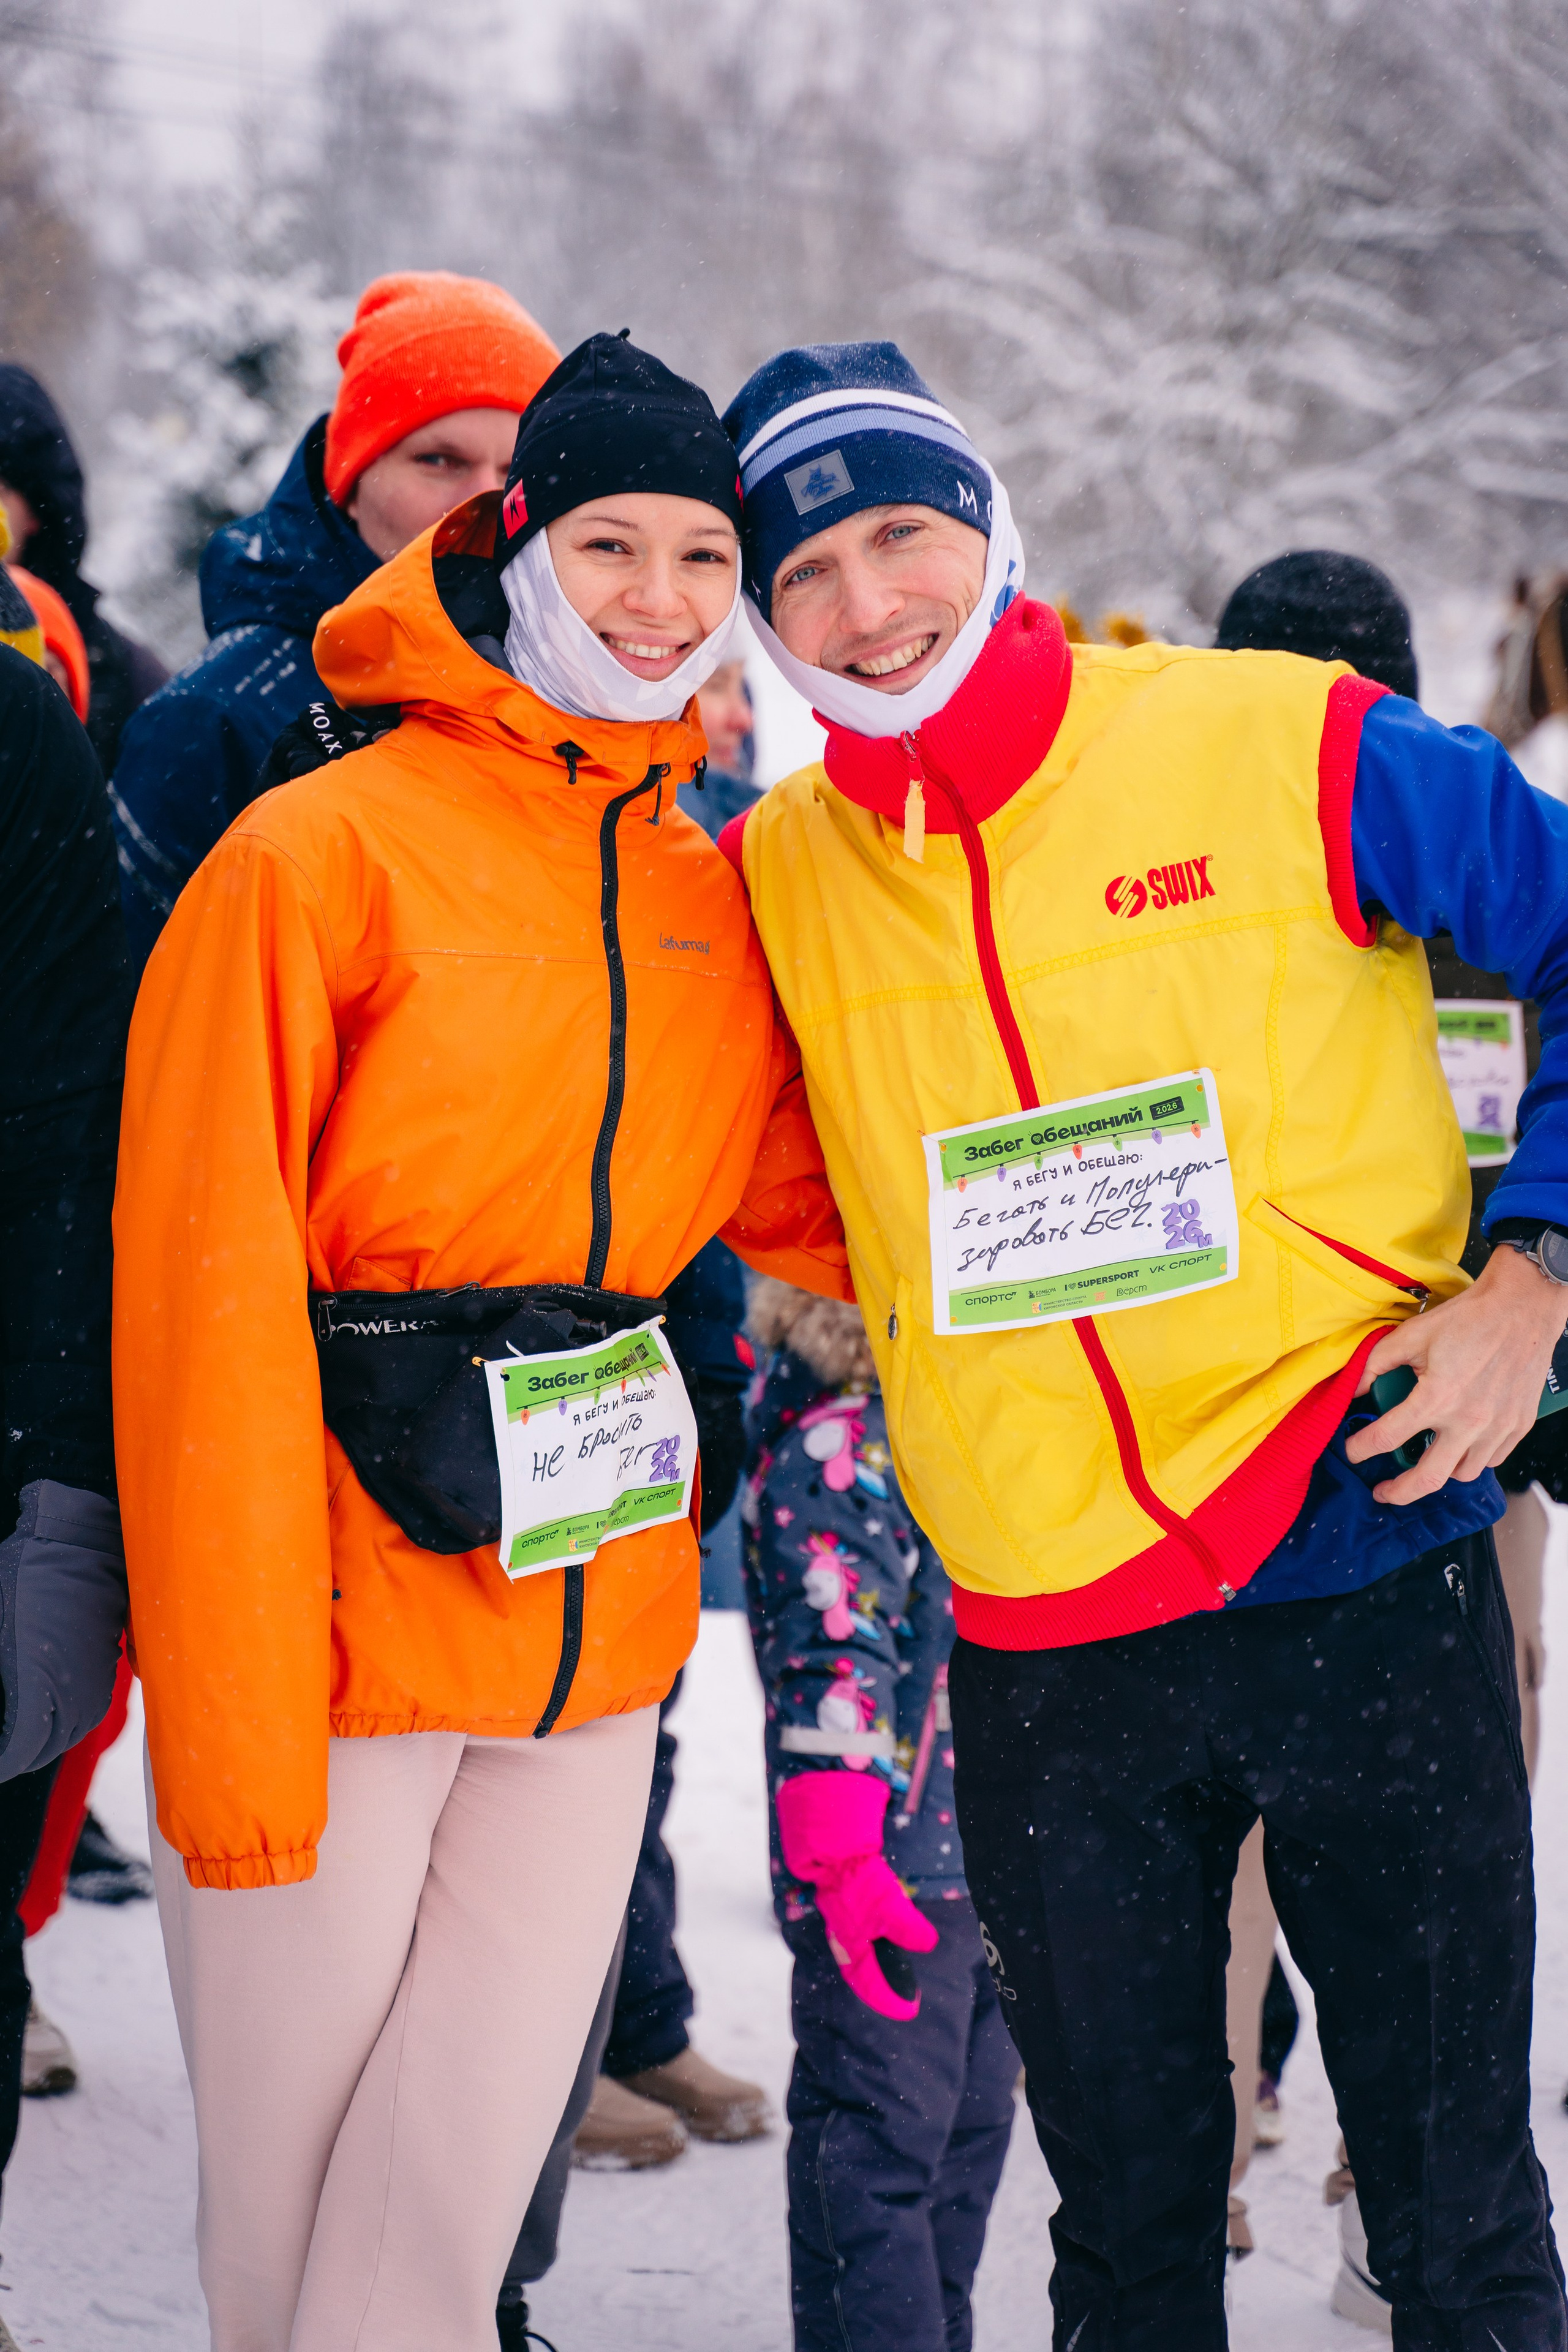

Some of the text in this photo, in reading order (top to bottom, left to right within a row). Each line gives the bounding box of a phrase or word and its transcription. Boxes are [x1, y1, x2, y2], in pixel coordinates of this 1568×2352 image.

[309, 702, 342, 755] MOAX
[964, 1137, 1024, 1161] Забег
[1155, 1102, 1178, 1115] 2026
[1013, 1180, 1022, 1191] Я
[1026, 1166, 1058, 1187] БЕГУ
[1063, 1164, 1073, 1176] И
[1160, 1198, 1200, 1227] 20
[1169, 1253, 1213, 1270] СПОРТ
[1077, 1269, 1140, 1289] SUPERSPORT
[1035, 1287, 1057, 1296] БОМБОРА
[527, 1371, 590, 1392] Забег
[573, 1414, 581, 1426] Я
[585, 1402, 609, 1421] БЕГУ
[612, 1399, 619, 1411] И
[647, 1488, 676, 1502] СПОРТ
